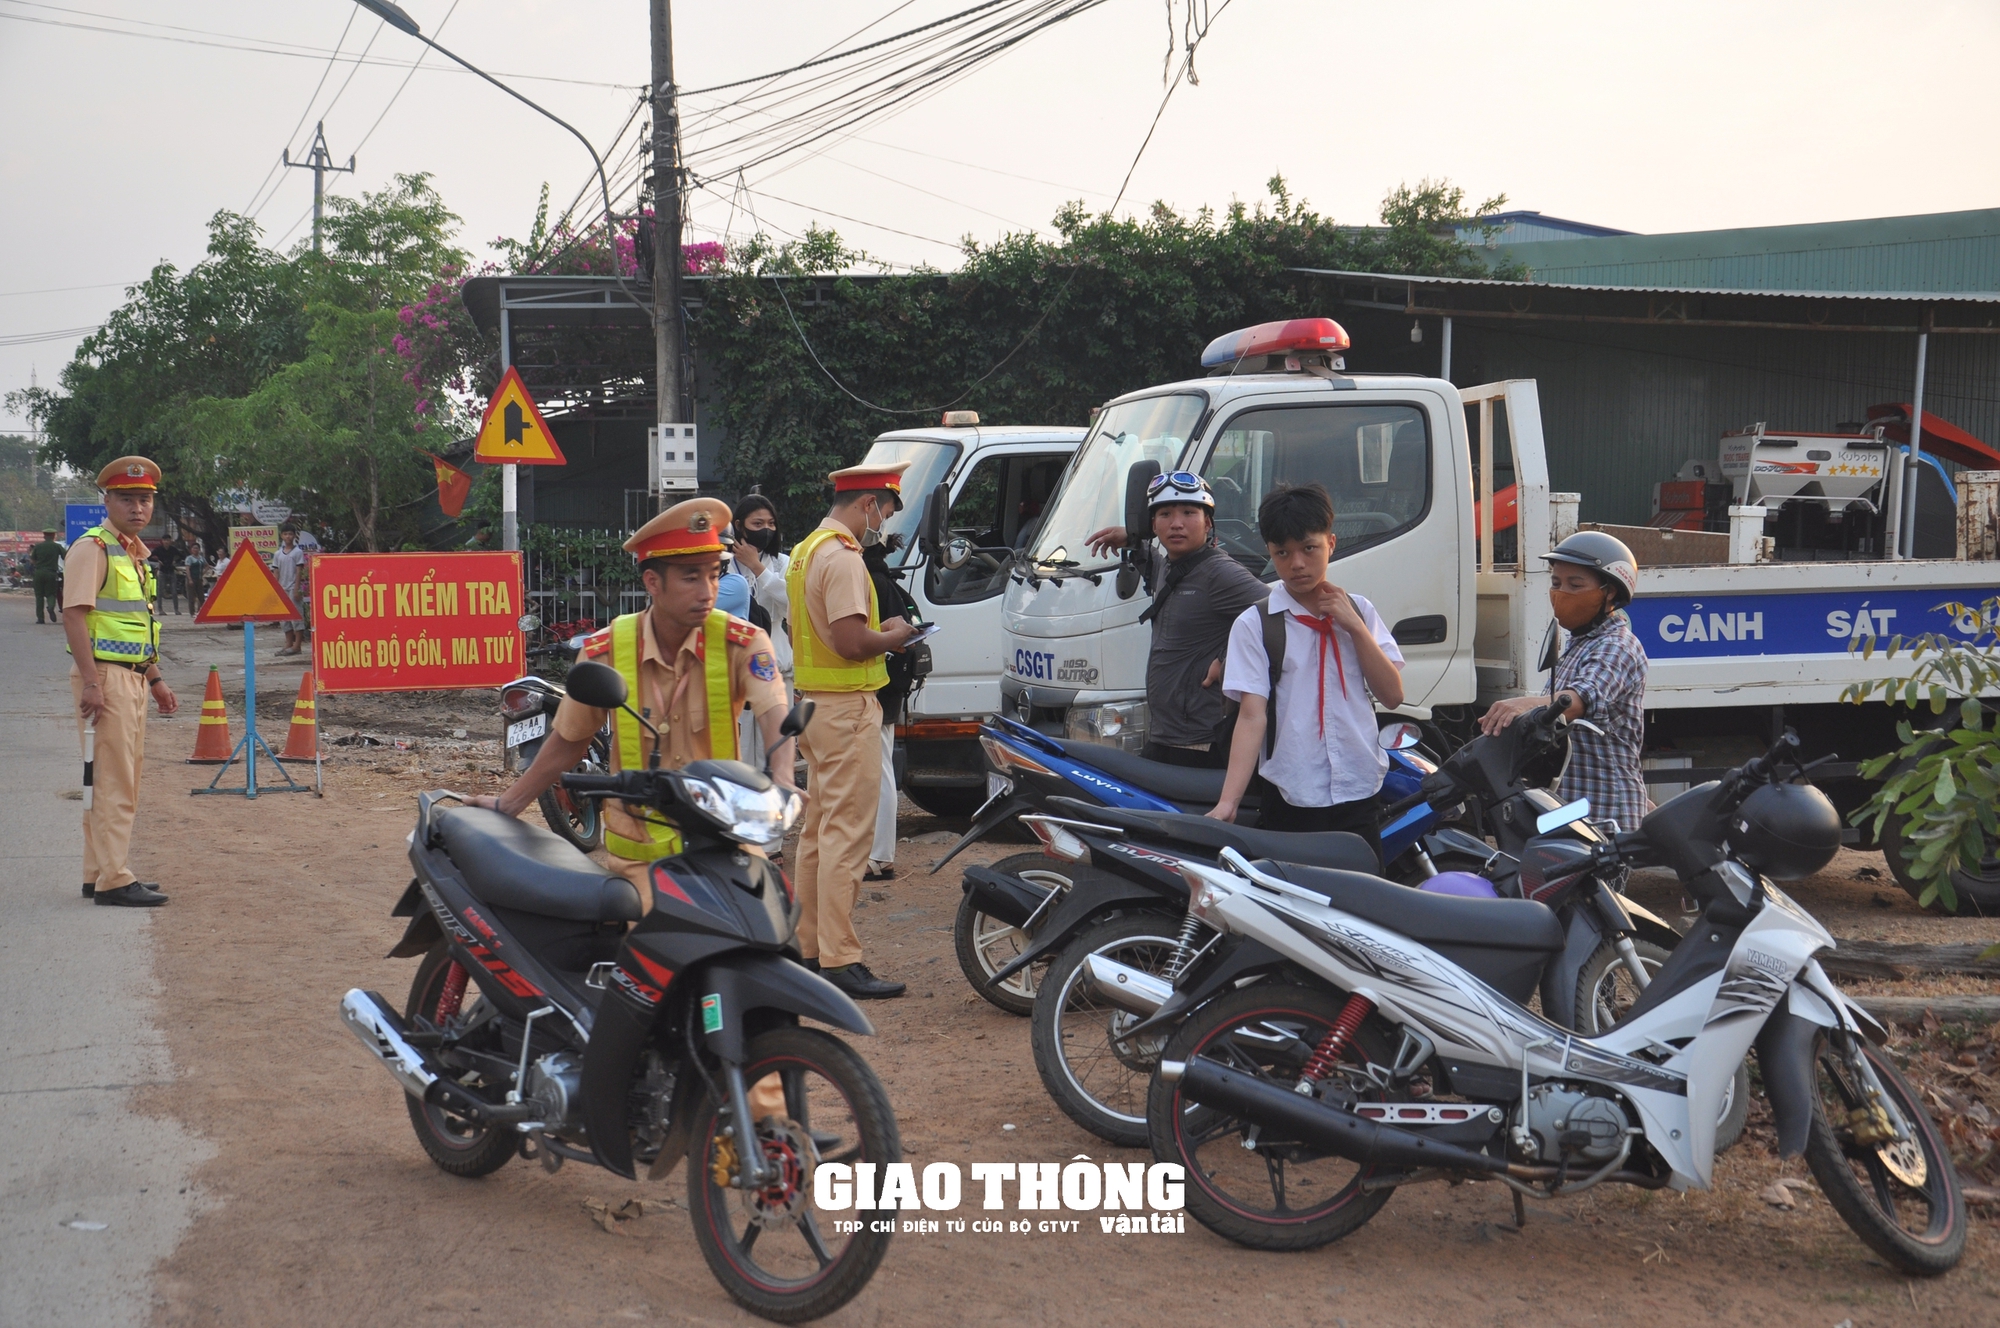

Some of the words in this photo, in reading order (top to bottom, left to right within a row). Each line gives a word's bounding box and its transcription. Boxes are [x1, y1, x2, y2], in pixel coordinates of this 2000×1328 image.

[1838, 451, 1879, 462] Kubota
[323, 571, 387, 619] CHỐT
[395, 568, 458, 617] KIỂM
[465, 581, 511, 615] TRA
[1659, 604, 1763, 643] CẢNH
[1827, 601, 1896, 638] SÁT
[322, 631, 372, 669] NỒNG
[377, 633, 400, 673] ĐỘ
[406, 629, 447, 669] CỒN,
[452, 637, 479, 665] MA
[484, 630, 515, 664] TUÝ
[1016, 648, 1054, 680] CSGT
[1057, 668, 1098, 685] DUTRO
[1071, 770, 1122, 794] LUVIA
[1107, 843, 1179, 867] BLAD
[1747, 948, 1788, 973] YAMAHA
